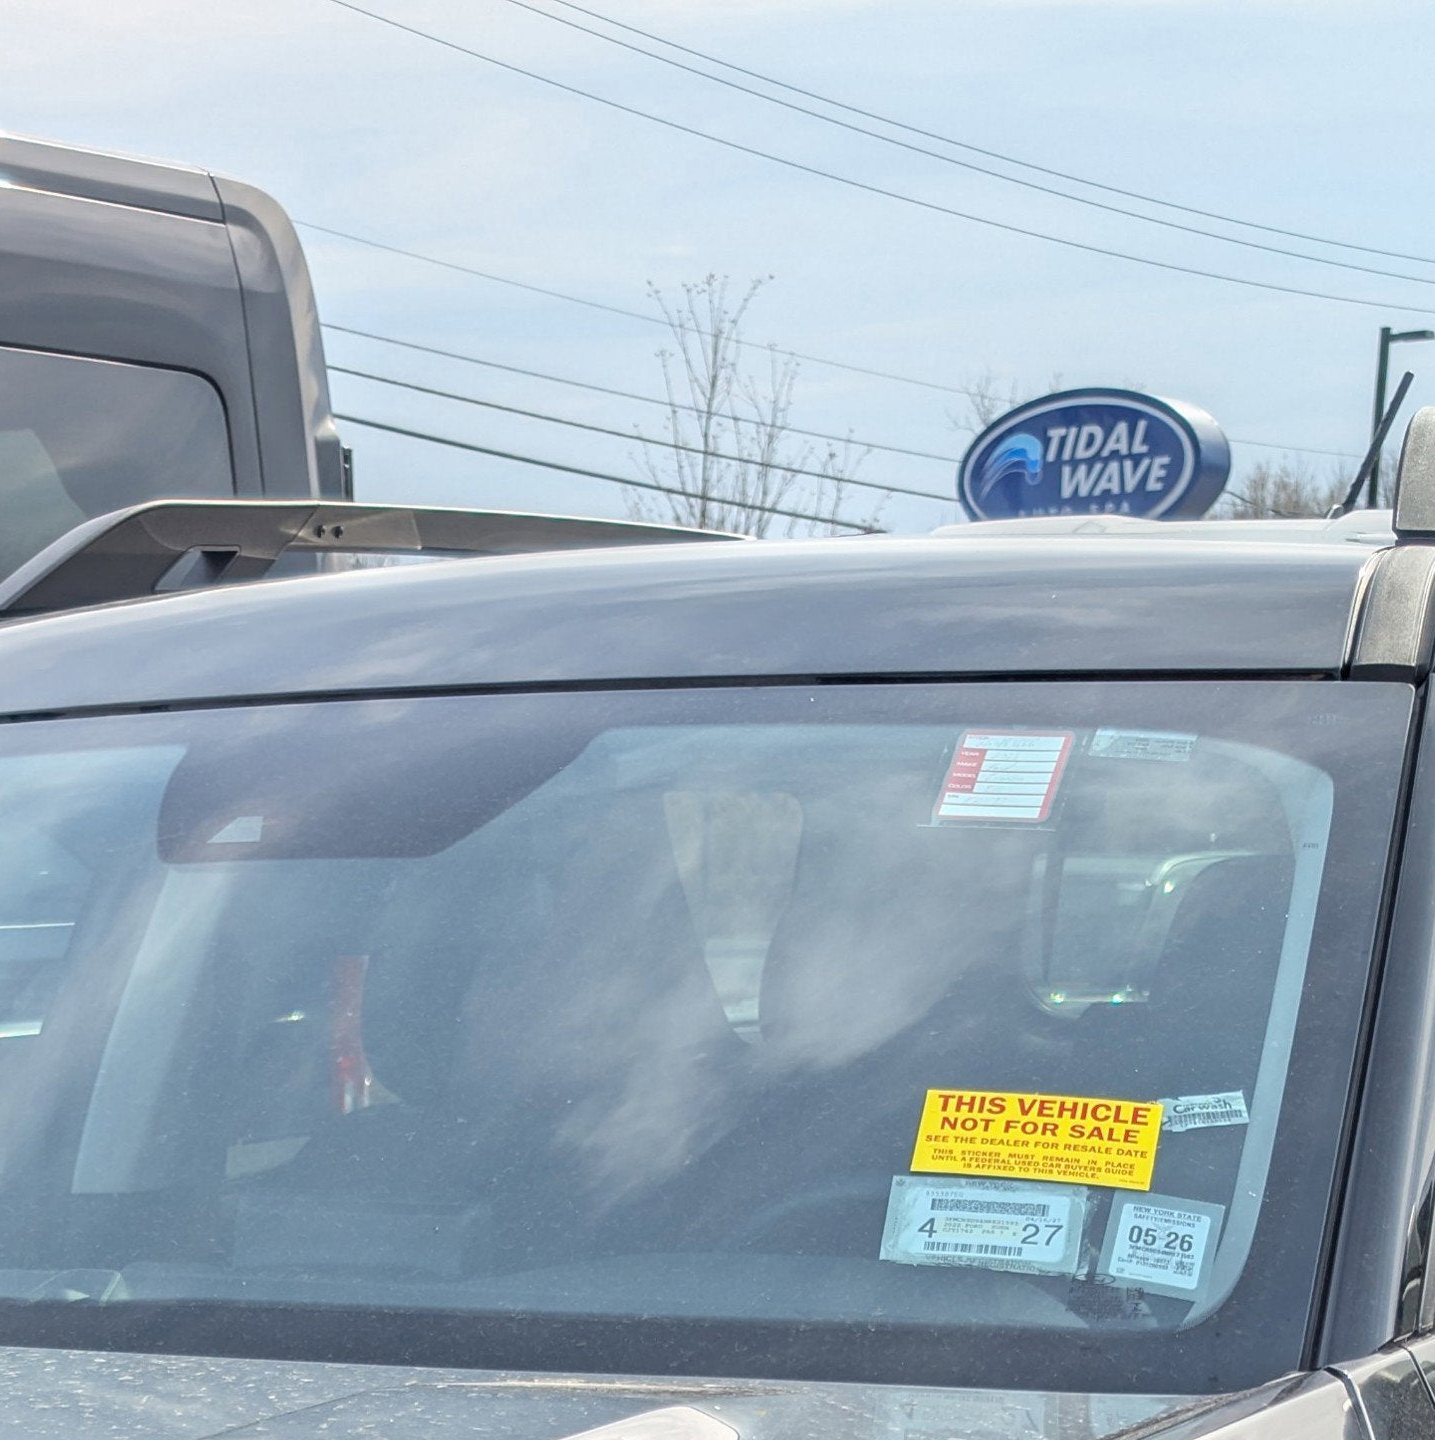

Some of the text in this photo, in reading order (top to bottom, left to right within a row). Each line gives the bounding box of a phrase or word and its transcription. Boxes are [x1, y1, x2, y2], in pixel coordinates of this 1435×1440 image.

[1046, 420, 1150, 462] TIDAL
[1060, 455, 1171, 500] WAVE
[938, 1094, 1006, 1115] THIS
[1018, 1098, 1151, 1126] VEHICLE
[940, 1116, 1140, 1144] NOT FOR SALE
[925, 1135, 1148, 1159] SEE THE DEALER FOR RESALE DATE
[932, 1154, 957, 1162] UNTIL
[968, 1157, 1012, 1166] FEDERAL
[1014, 1159, 1040, 1167] USED
[1042, 1162, 1062, 1170] CAR
[1064, 1163, 1102, 1173] BUYERS
[1104, 1167, 1134, 1176] GUIDE
[961, 1150, 1001, 1158] STICKER
[1008, 1152, 1035, 1160] MUST
[1042, 1155, 1081, 1164] REMAIN
[1104, 1161, 1135, 1170] PLACE
[975, 1163, 1015, 1172] AFFIXED
[1018, 1165, 1030, 1173] TO
[1033, 1167, 1054, 1175] THIS
[1057, 1169, 1099, 1180] VEHICLE.
[1133, 1205, 1202, 1223] NEW YORK STATE
[918, 1218, 937, 1238] 4
[1020, 1223, 1064, 1246] 27
[1128, 1225, 1194, 1252] 05 26
